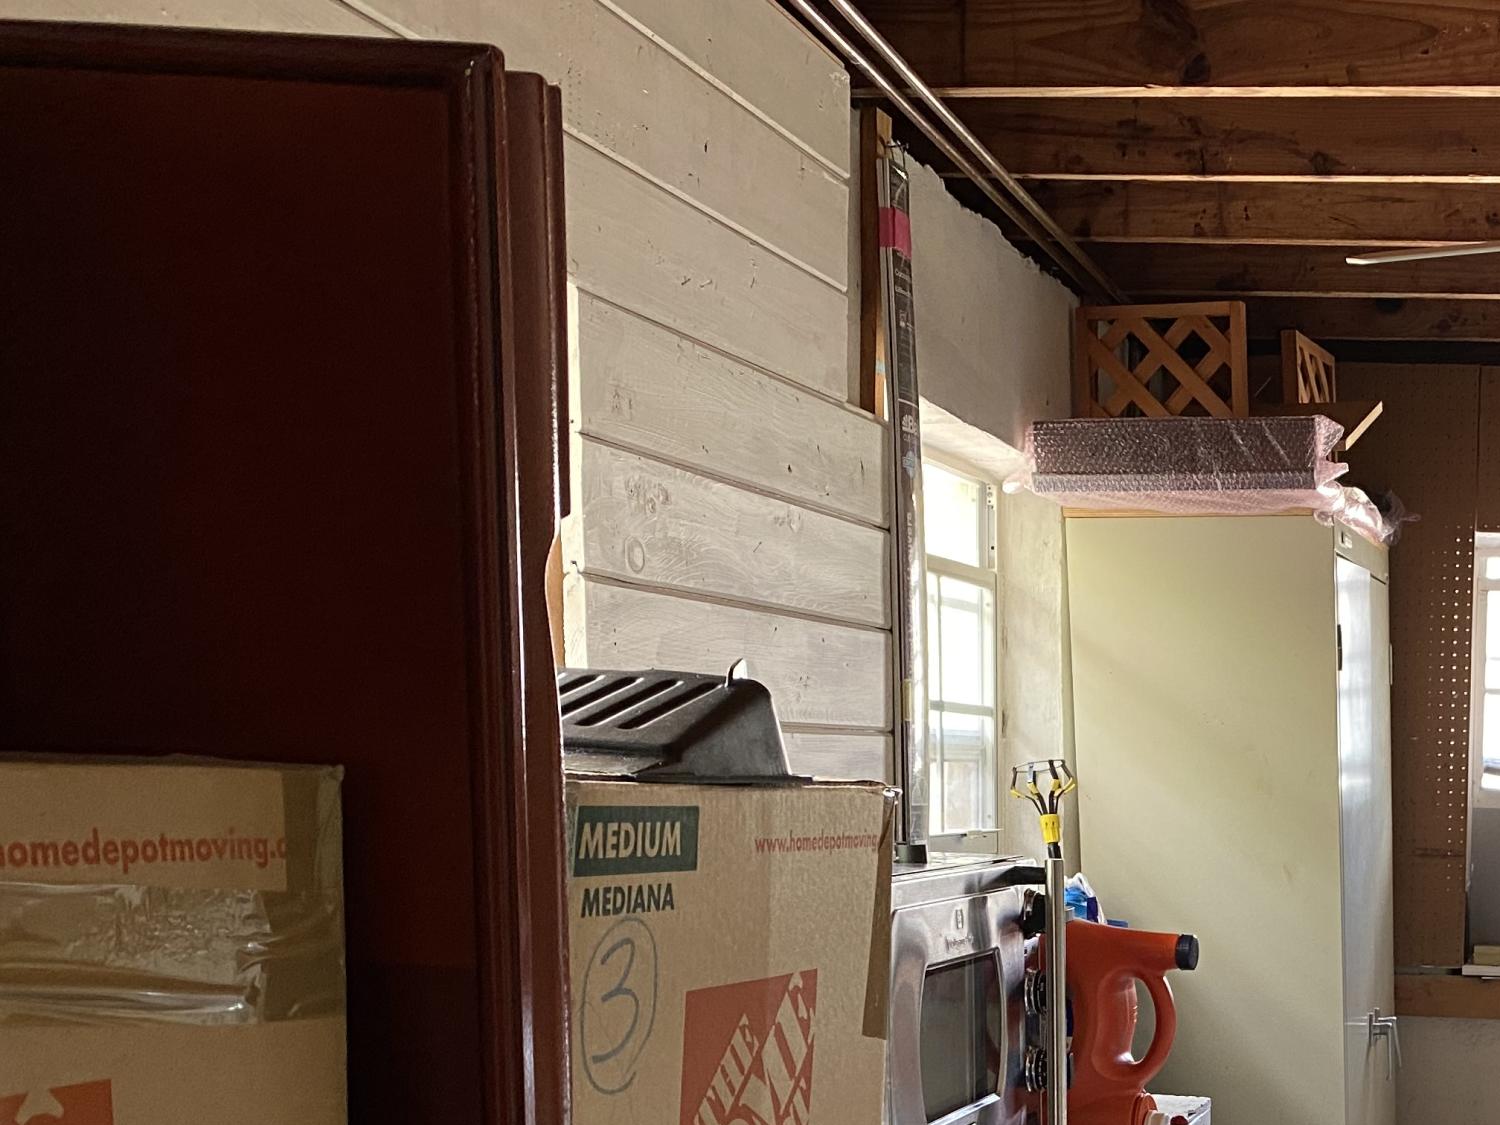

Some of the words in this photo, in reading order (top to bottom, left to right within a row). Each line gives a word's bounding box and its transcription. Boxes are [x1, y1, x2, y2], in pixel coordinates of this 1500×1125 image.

[577, 820, 682, 860] MEDIUM
[579, 883, 676, 919] MEDIANA
[592, 937, 641, 1065] 3
